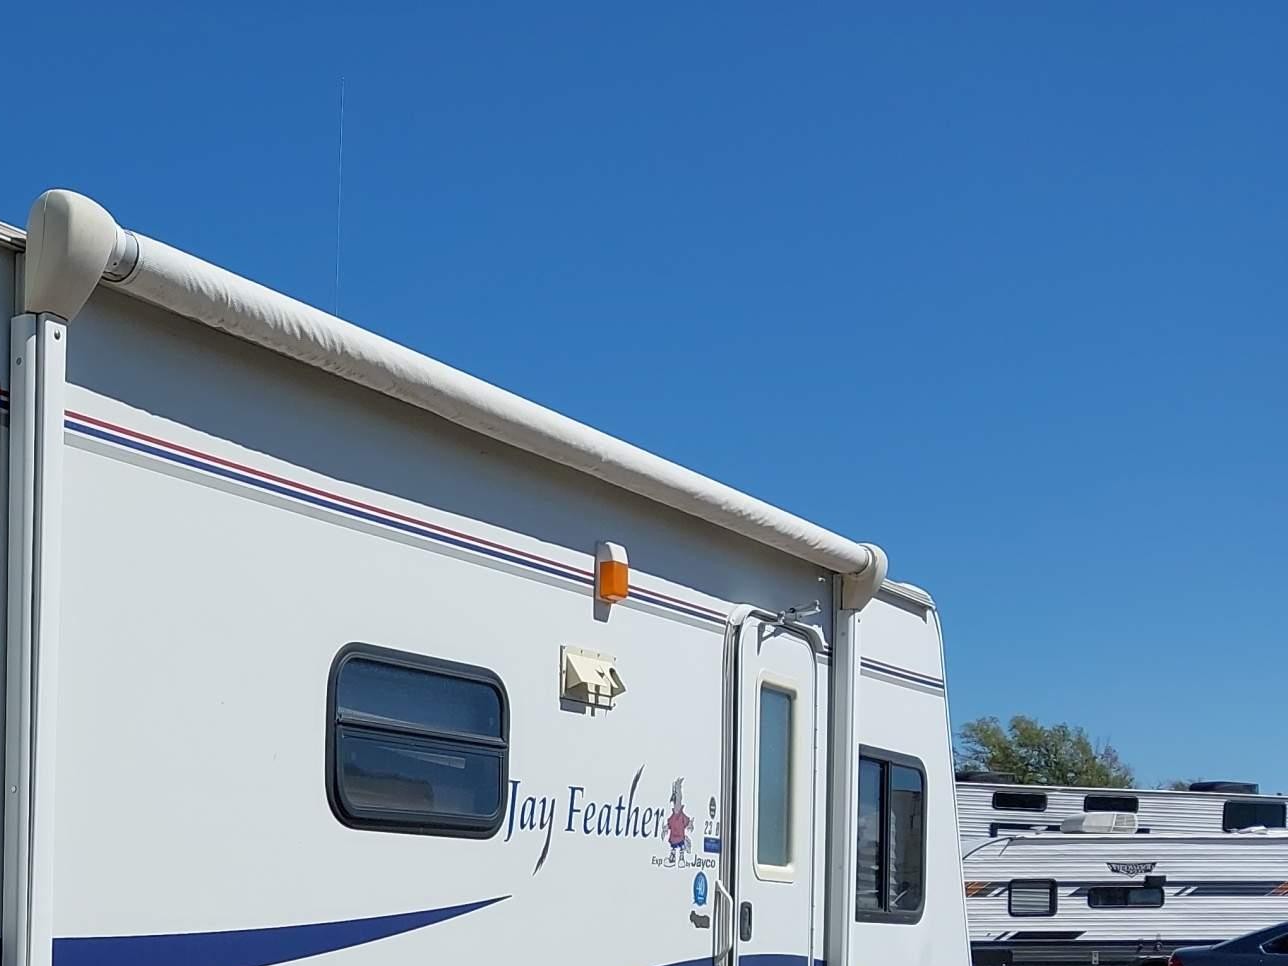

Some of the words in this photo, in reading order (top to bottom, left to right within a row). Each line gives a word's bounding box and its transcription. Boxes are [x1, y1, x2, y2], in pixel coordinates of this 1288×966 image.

[503, 779, 556, 876] Jay
[564, 763, 665, 839] Feather
[651, 856, 663, 868] Exp
[691, 853, 716, 870] Jayco
